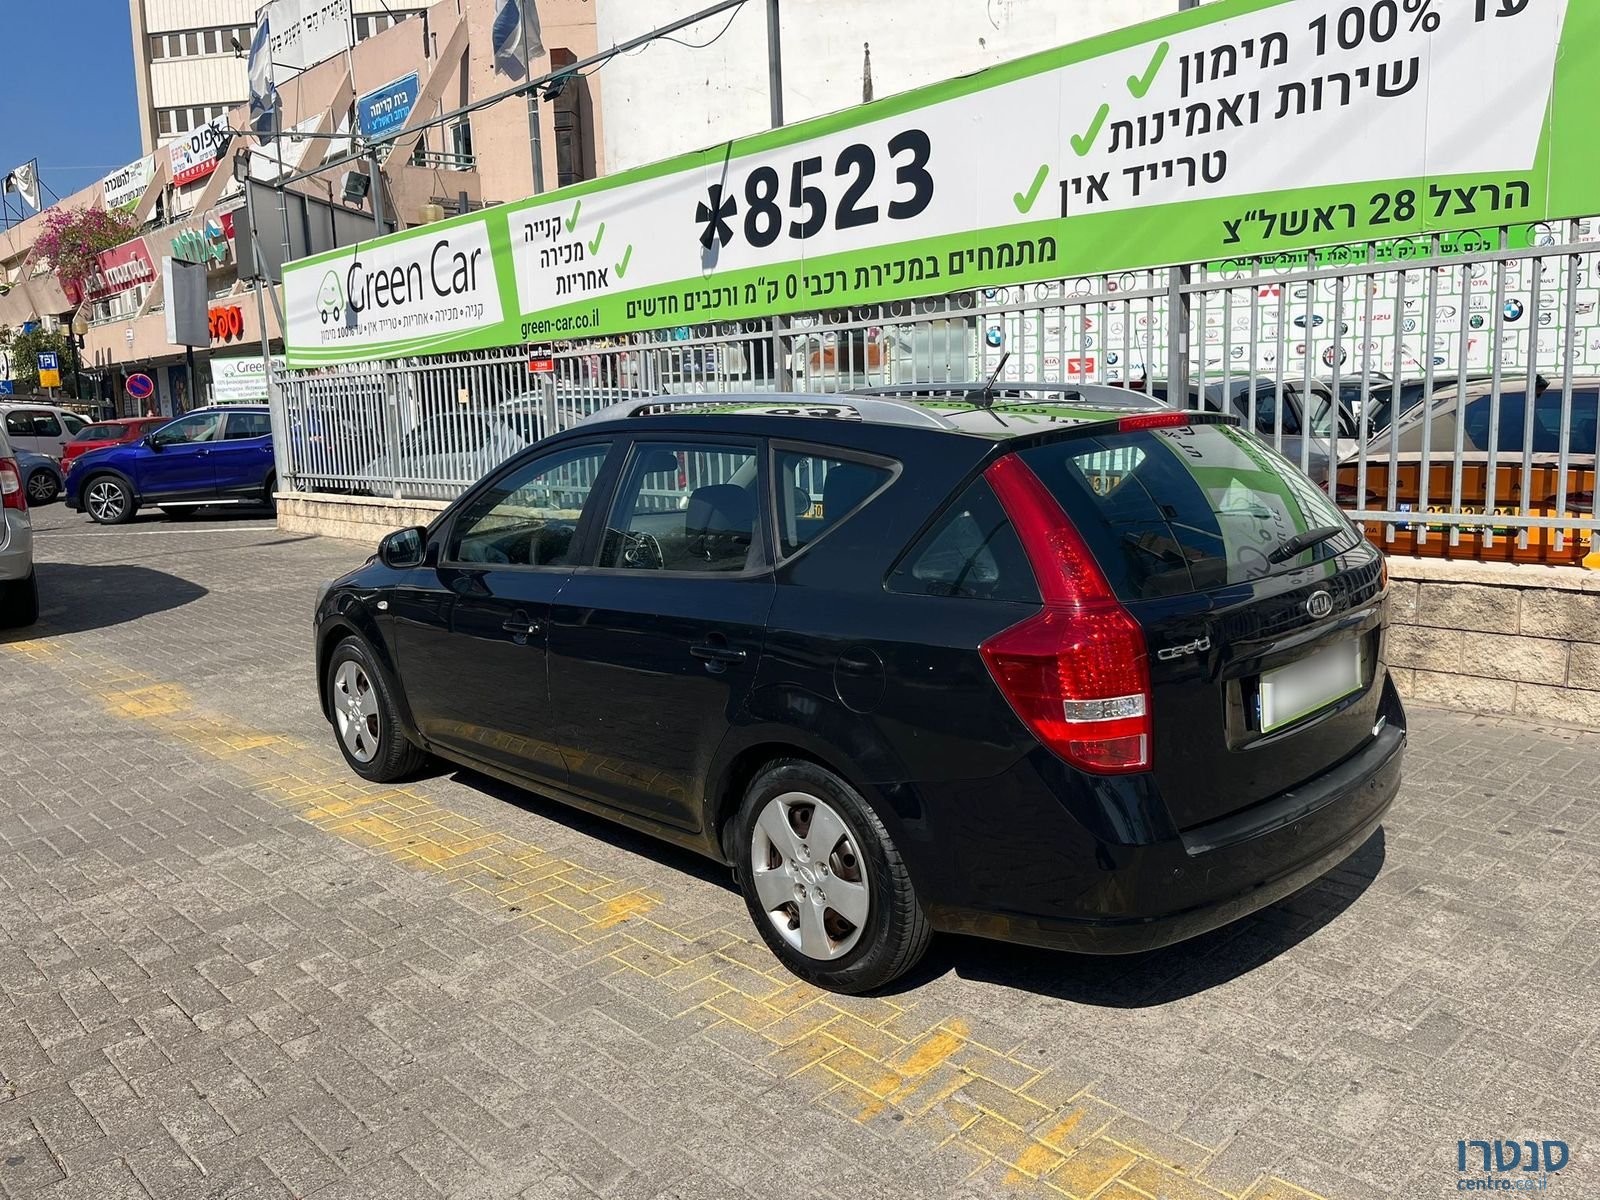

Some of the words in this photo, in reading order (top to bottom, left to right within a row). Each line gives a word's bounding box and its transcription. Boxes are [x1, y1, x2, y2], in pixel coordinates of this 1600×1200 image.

[1309, 0, 1441, 56] 100%
[1179, 29, 1288, 98] מימון
[394, 91, 408, 107] בית
[1275, 55, 1420, 120] שירות
[370, 97, 393, 117] קדימה
[1108, 89, 1259, 154] ואמינות
[104, 169, 130, 193] להשכרה
[1123, 147, 1227, 197] טרייד
[1058, 170, 1110, 219] אין
[1370, 191, 1416, 223] 28
[1429, 179, 1530, 221] הרצל
[525, 216, 562, 242] קנייה
[540, 241, 584, 269] מכירה
[949, 235, 1057, 276] מתמחים
[1421, 243, 1458, 255] נשר
[347, 260, 424, 313] Green
[431, 240, 481, 297] Car
[556, 267, 609, 296] אחריות
[785, 273, 798, 299] 0
[803, 270, 848, 298] רכבי
[855, 254, 940, 292] במכירת
[465, 303, 483, 320] קניה
[626, 294, 679, 319] חדשים
[685, 284, 739, 314] ורכבים
[379, 318, 397, 331] טרייד
[403, 312, 429, 328] אחריות
[435, 307, 459, 323] מכירה
[521, 314, 600, 340] green-car.co.il
[321, 329, 336, 344] מימון
[337, 325, 355, 338] 100%
[367, 321, 378, 337] אין
